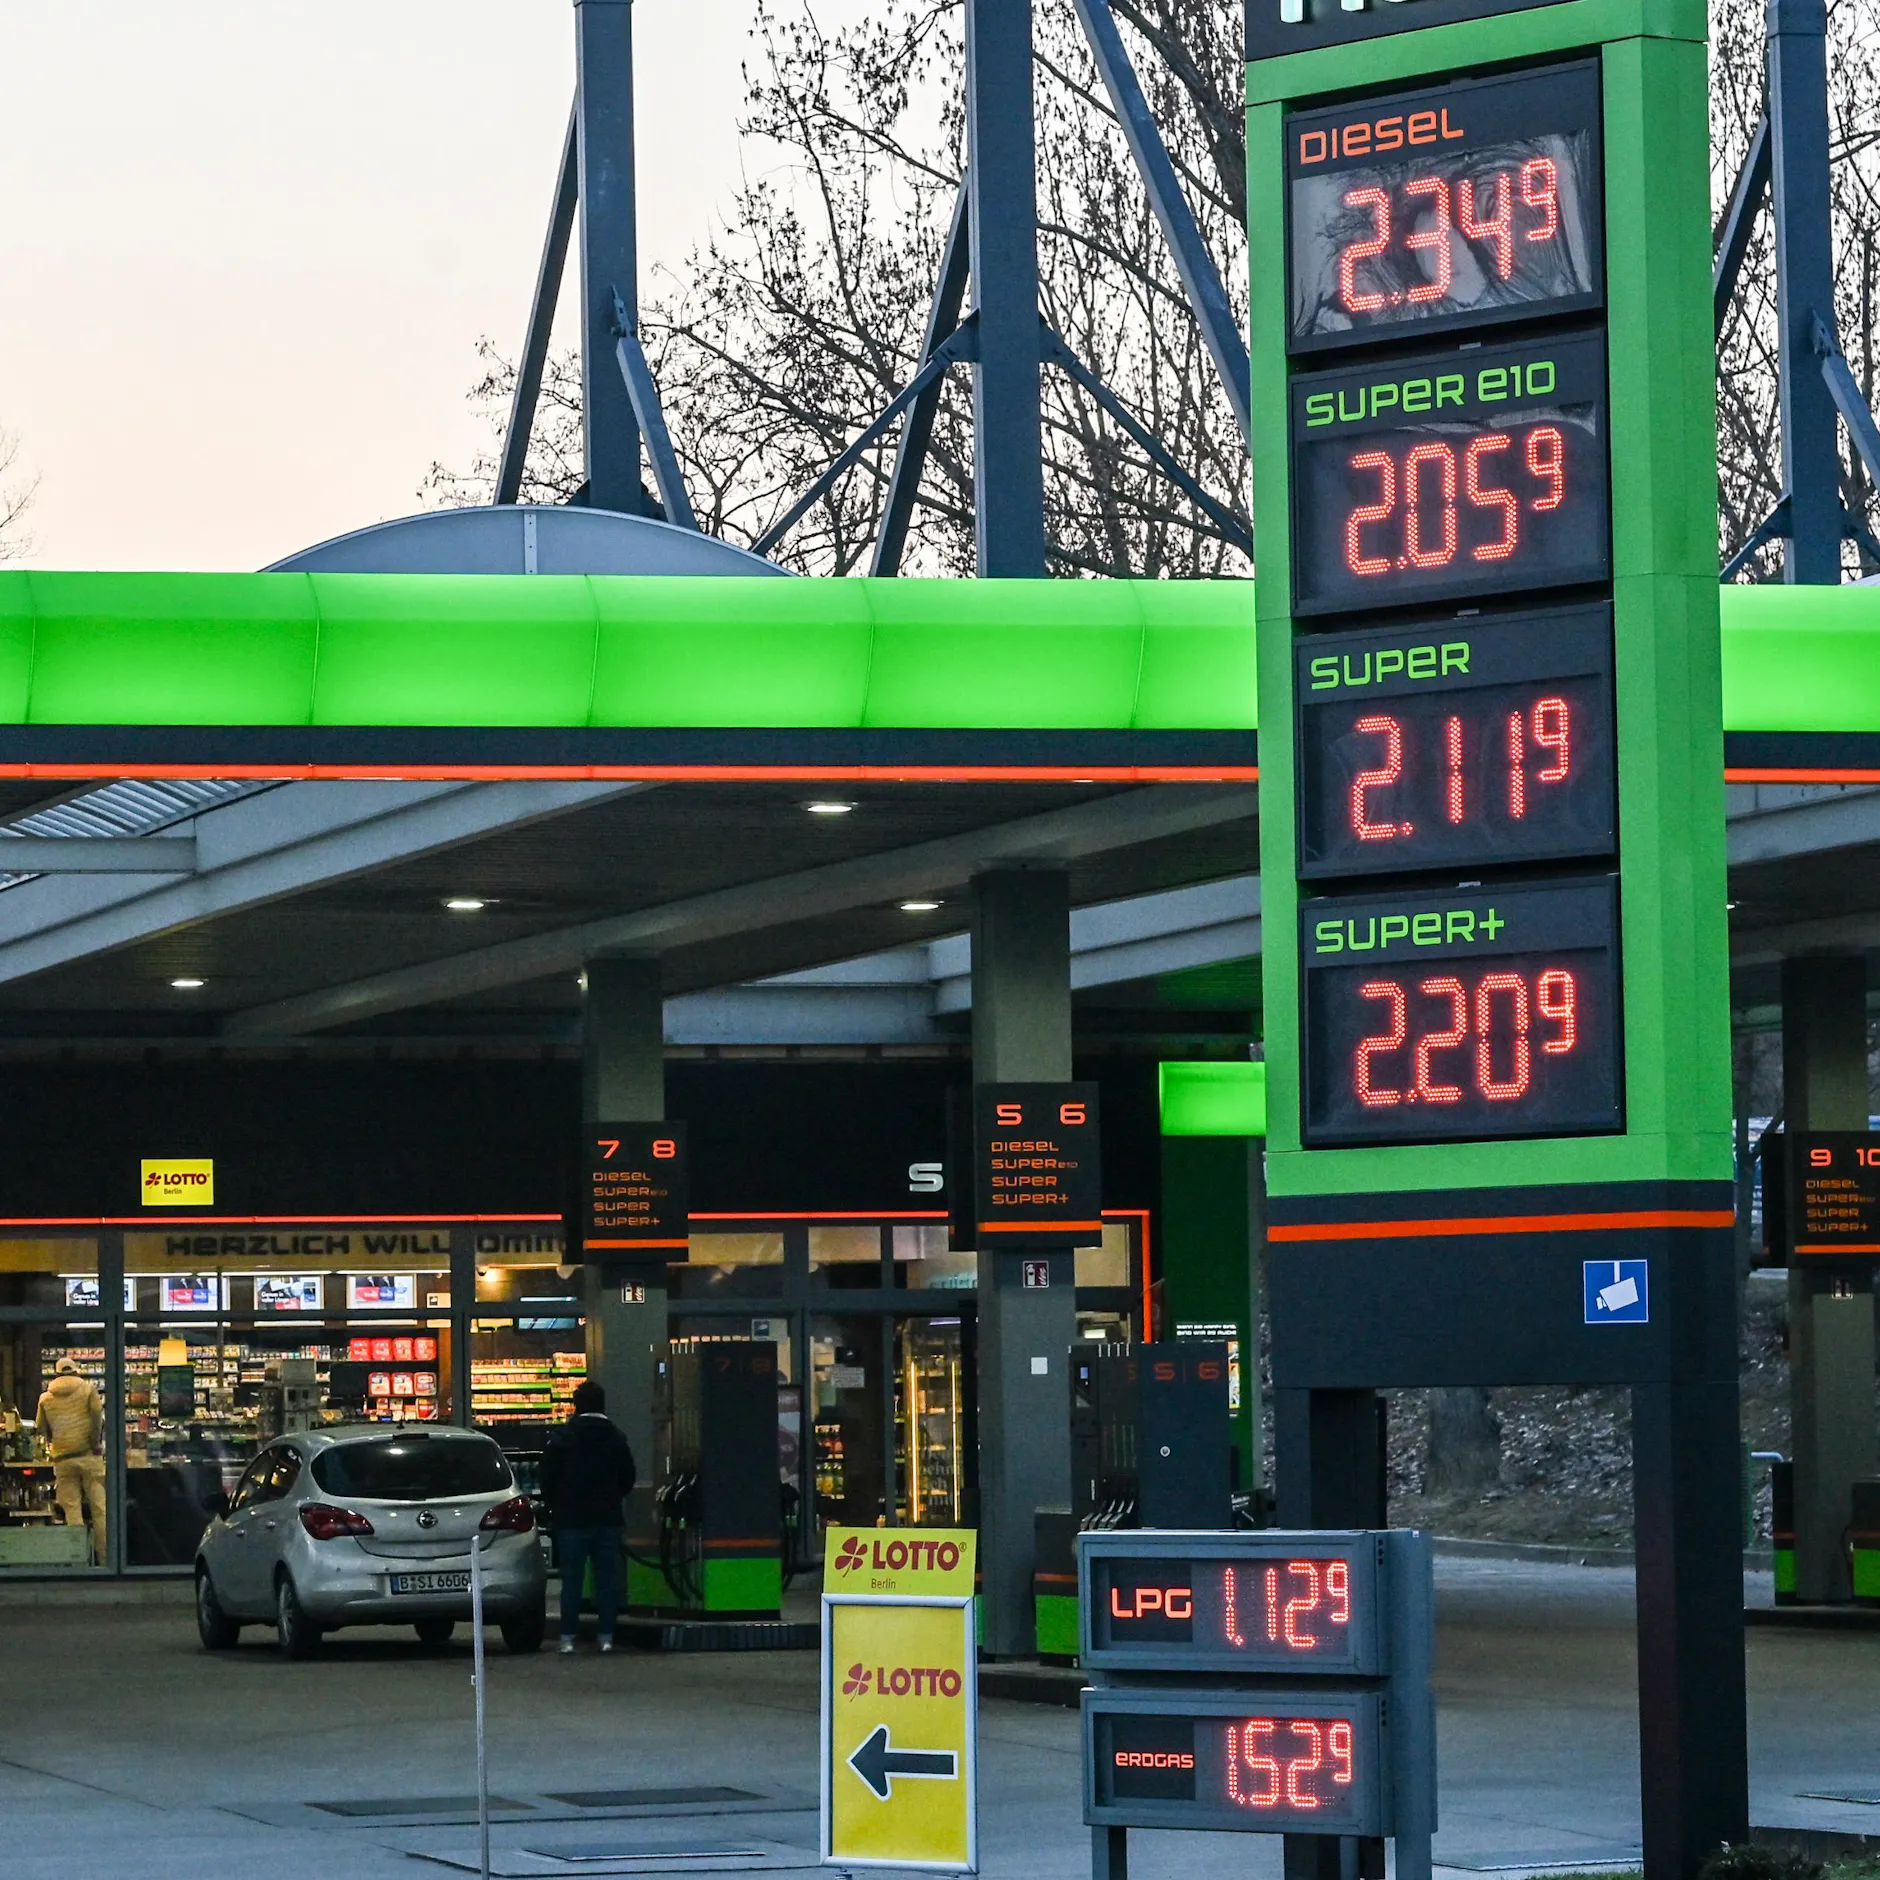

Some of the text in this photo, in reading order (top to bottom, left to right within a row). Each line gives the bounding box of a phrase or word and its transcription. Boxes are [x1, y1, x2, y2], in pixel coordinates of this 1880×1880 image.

[1301, 109, 1464, 163] DIESEL
[1305, 373, 1465, 427] SUPER
[1310, 642, 1470, 690] SUPER
[1315, 908, 1505, 953] SUPER+
[996, 1103, 1087, 1126] 5 6
[598, 1139, 676, 1159] 7 8
[991, 1141, 1060, 1153] DIESEL
[1810, 1148, 1832, 1167] 9
[164, 1173, 208, 1186] LOTTO
[592, 1171, 651, 1182] DIESEL
[991, 1176, 1058, 1187] SUPER
[1806, 1179, 1860, 1189] DIESEL
[991, 1193, 1070, 1205] SUPER+
[593, 1202, 650, 1212] SUPER
[1806, 1208, 1859, 1218] SUPER
[593, 1216, 660, 1227] SUPER+
[1807, 1222, 1868, 1232] SUPER+
[400, 1577, 408, 1589] B
[871, 1578, 896, 1589] Berlin
[1111, 1588, 1192, 1618] LPG
[877, 1667, 962, 1698] LOTTO
[1115, 1752, 1194, 1768] ERDGAS
